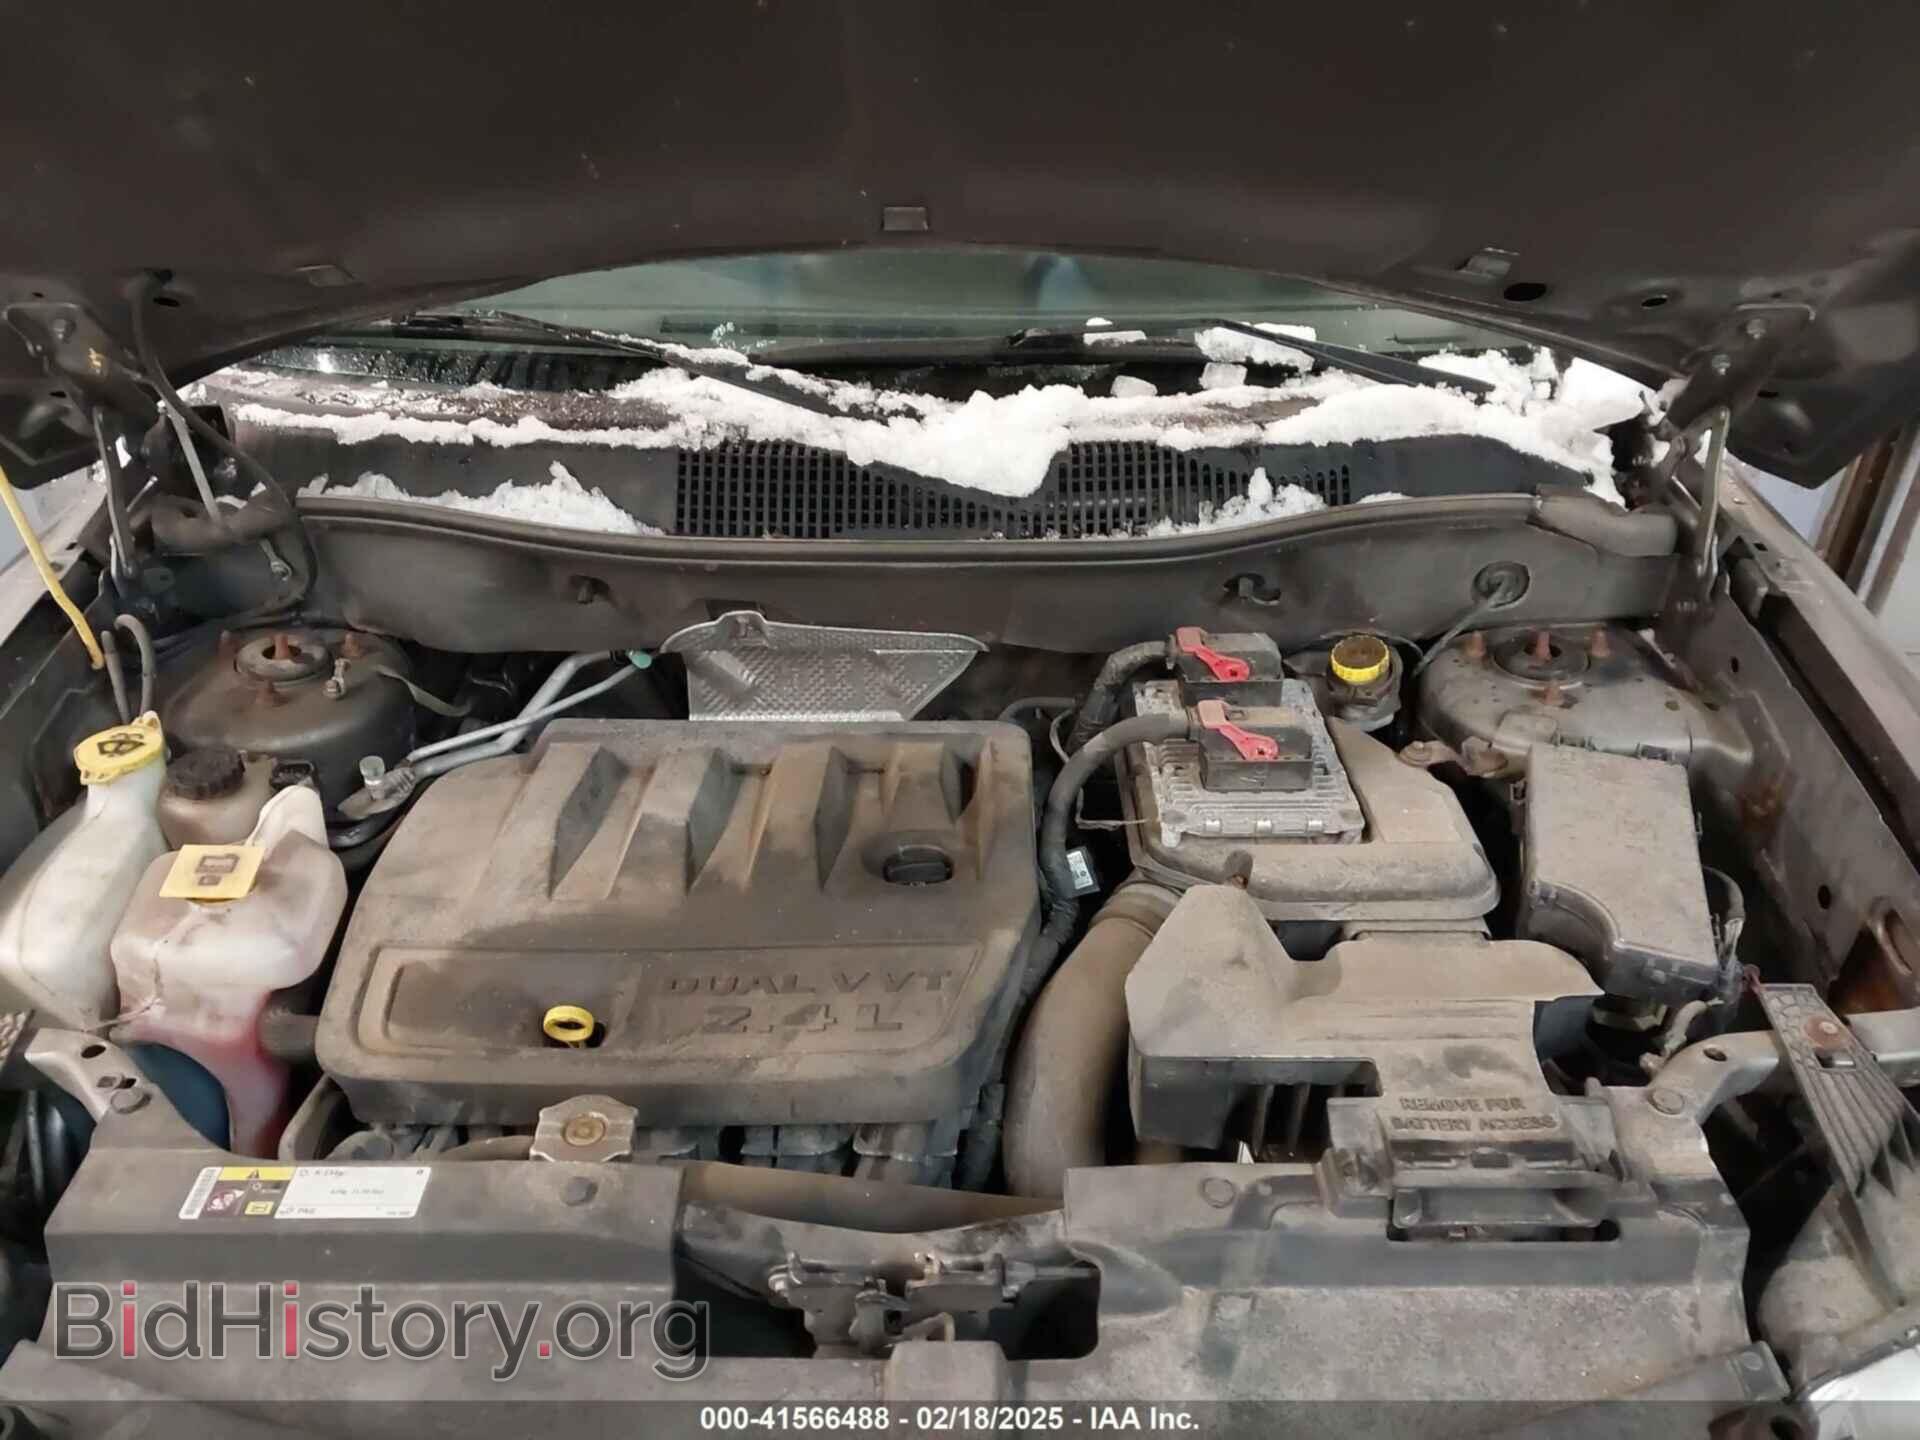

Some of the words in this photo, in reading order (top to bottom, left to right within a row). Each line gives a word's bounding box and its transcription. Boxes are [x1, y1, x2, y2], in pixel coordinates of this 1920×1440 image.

[671, 974, 816, 995] DUAL
[832, 971, 952, 992] VVT
[703, 1003, 903, 1034] 2.4L
[1400, 1097, 1483, 1112] REMOVE
[1484, 1097, 1526, 1111] FOR
[1391, 1116, 1471, 1131] BATTERY
[1479, 1115, 1557, 1131] ACCESS
